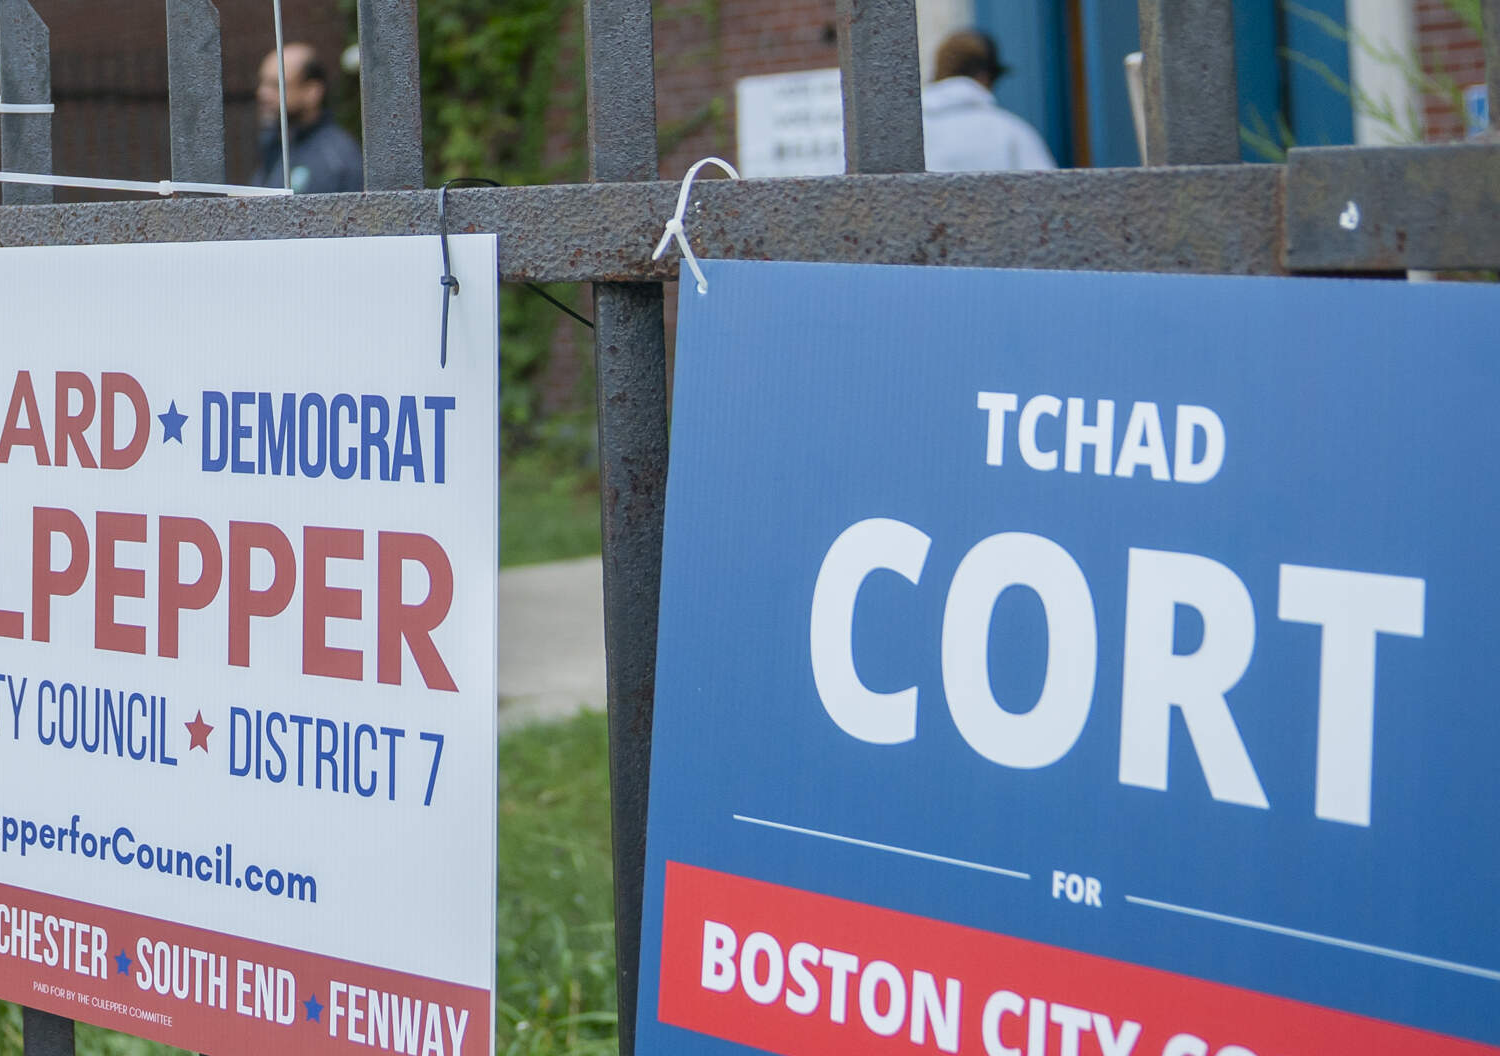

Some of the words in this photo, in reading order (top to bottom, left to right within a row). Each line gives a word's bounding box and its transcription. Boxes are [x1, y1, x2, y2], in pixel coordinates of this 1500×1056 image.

[201, 390, 455, 484] DEMOCRAT
[977, 391, 1227, 484] TCHAD
[810, 517, 1426, 828] CORT
[37, 679, 177, 767] COUNCIL
[229, 706, 405, 802] DISTRICT
[419, 732, 445, 807] 7
[1051, 870, 1102, 907] FOR
[33, 981, 49, 994] PAID
[50, 985, 66, 999] FOR
[66, 989, 76, 1001] BY
[77, 992, 90, 1005] THE
[129, 1006, 173, 1027] COMMITTEE
[135, 936, 227, 1009] SOUTH
[236, 960, 296, 1025] END
[329, 980, 469, 1056] FENWAY
[701, 919, 961, 1054] BOSTON
